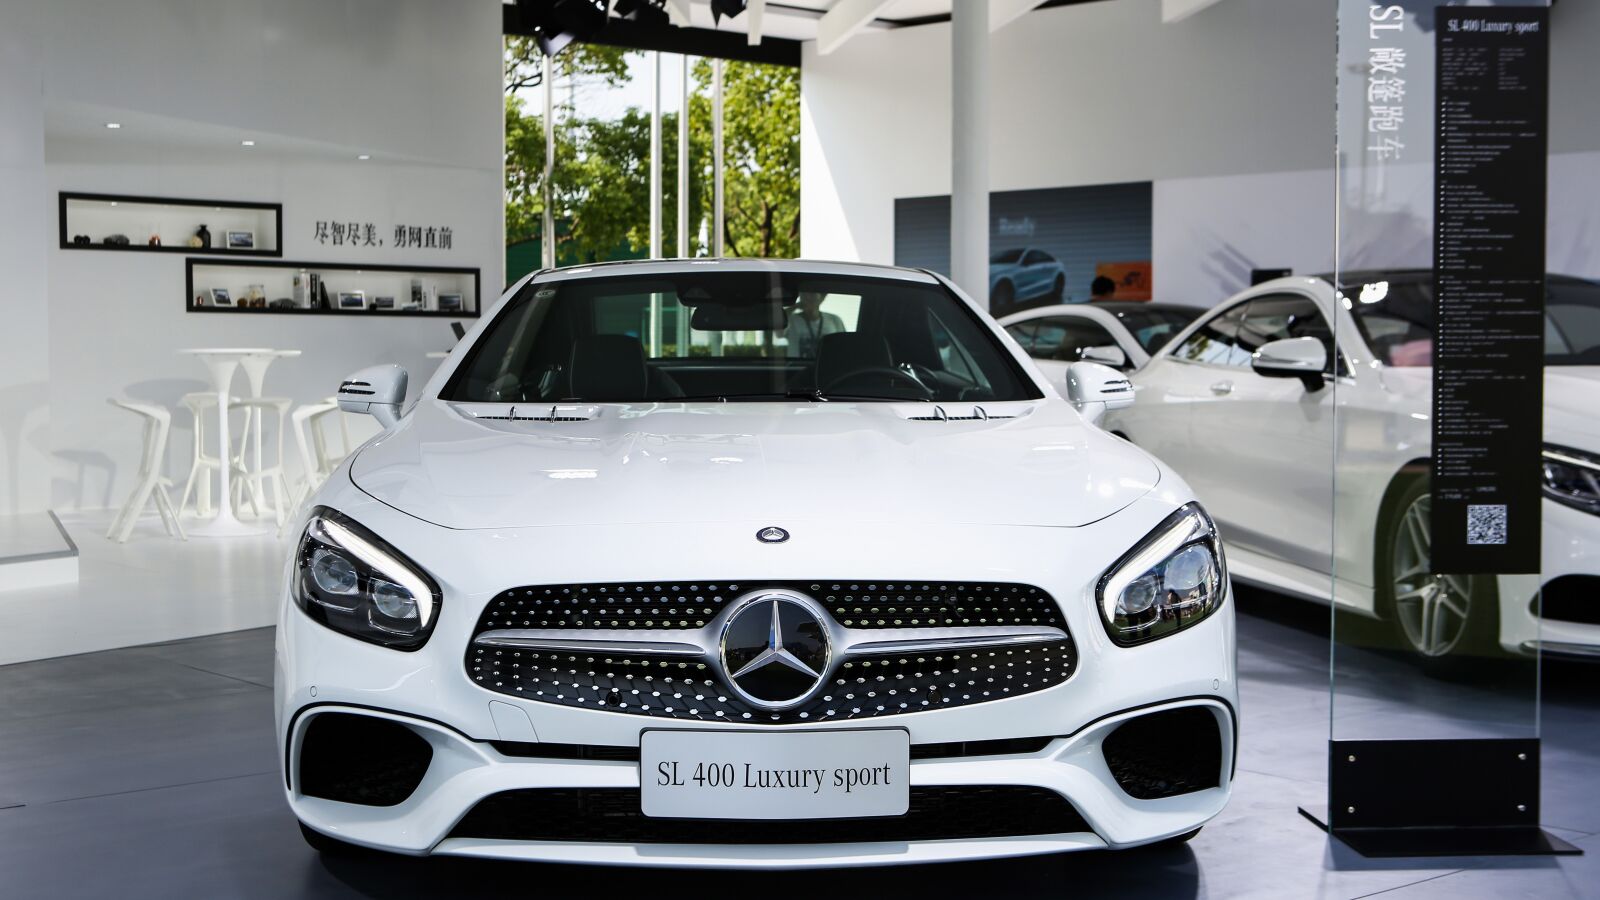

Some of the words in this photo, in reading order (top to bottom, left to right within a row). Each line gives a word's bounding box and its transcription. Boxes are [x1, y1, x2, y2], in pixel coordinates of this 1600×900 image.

[1369, 5, 1404, 39] SL
[1367, 47, 1407, 161] 敞篷跑车
[657, 761, 685, 787] SL
[692, 762, 735, 788] 400
[743, 763, 826, 794] Luxury
[833, 762, 891, 794] sport
